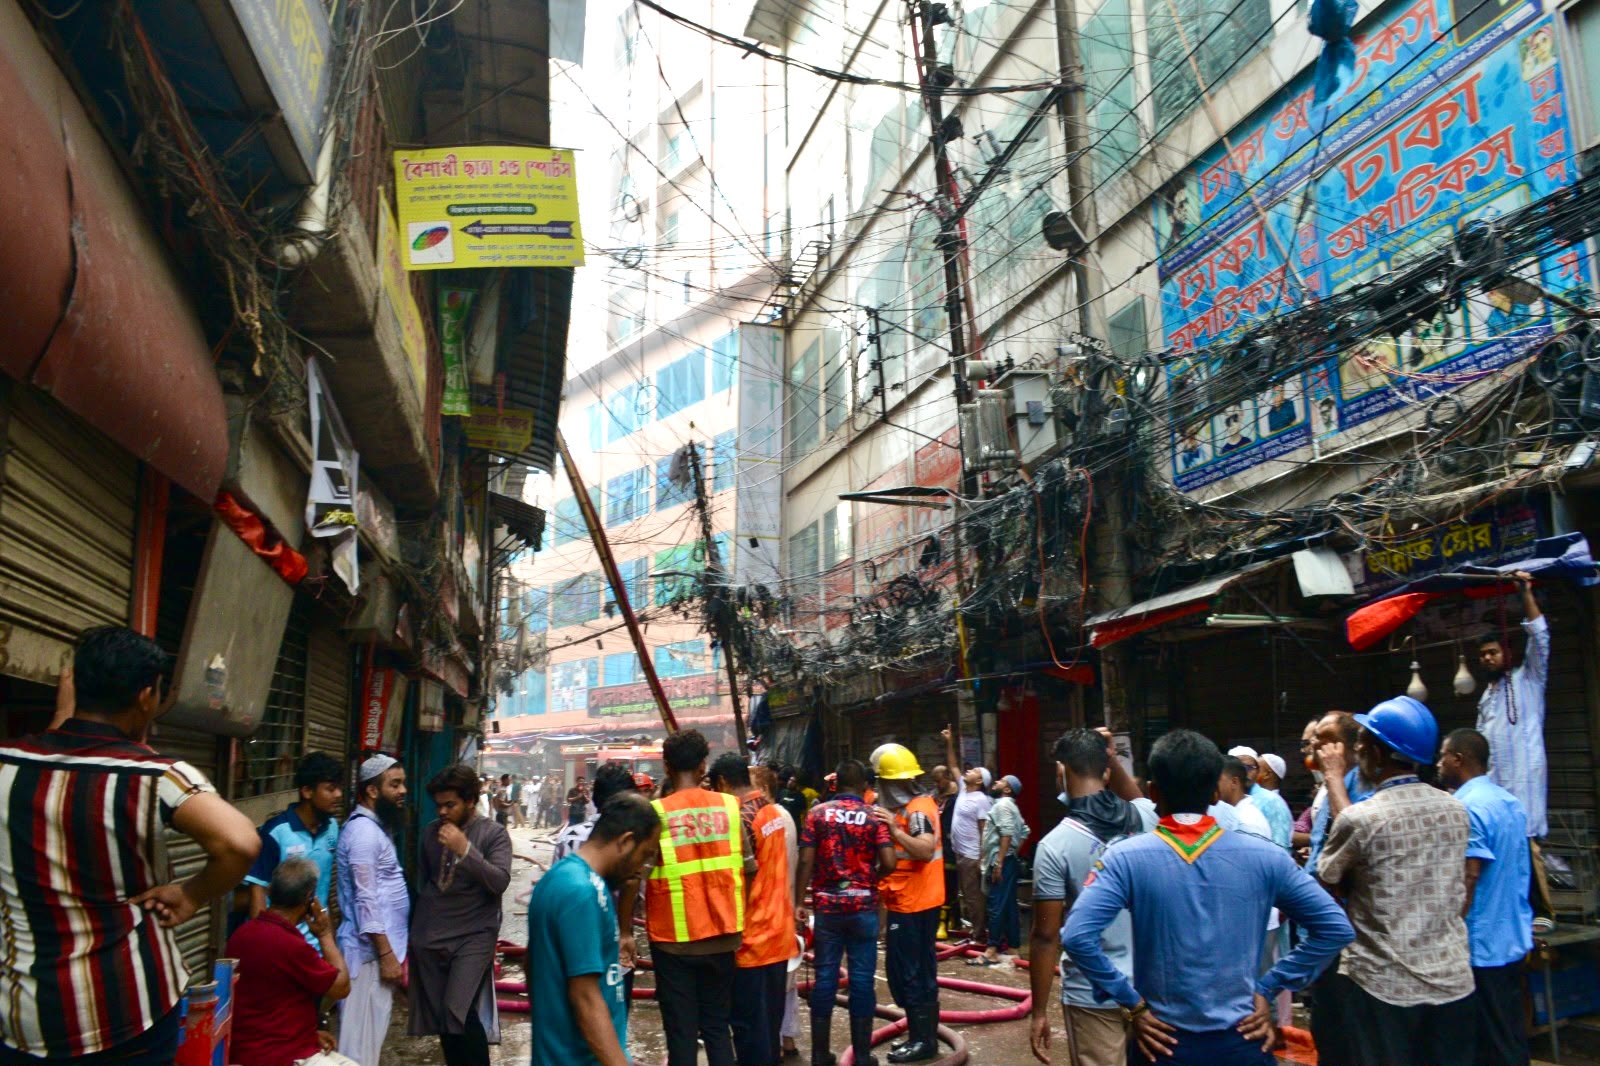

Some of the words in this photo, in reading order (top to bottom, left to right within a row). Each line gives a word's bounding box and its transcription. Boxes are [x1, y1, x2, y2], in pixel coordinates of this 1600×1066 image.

[1341, 71, 1482, 203] ঢাকা
[401, 153, 458, 181] বৈশাখী
[462, 160, 494, 179] ছাতা
[1199, 126, 1265, 203] ঢাকা
[1177, 219, 1268, 309] ঢাকা
[668, 811, 731, 841] FSCD
[825, 808, 868, 826] FSCD
